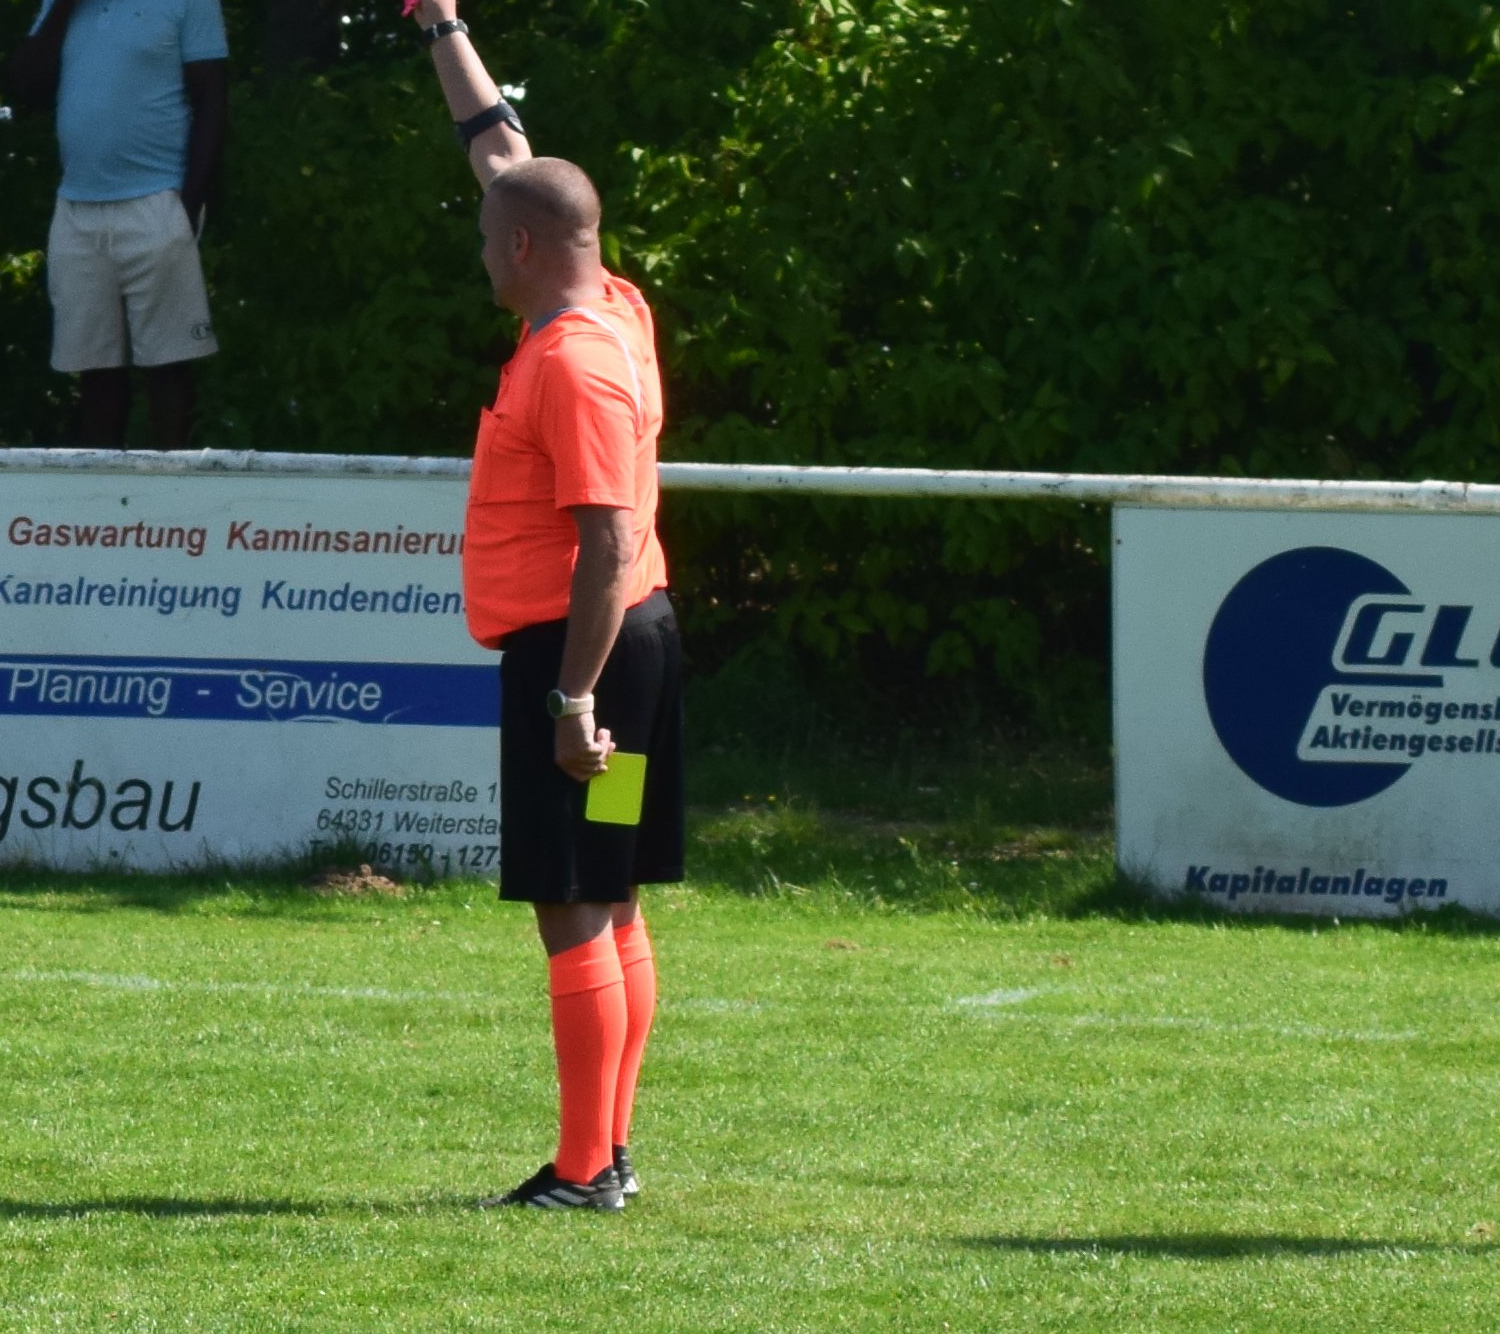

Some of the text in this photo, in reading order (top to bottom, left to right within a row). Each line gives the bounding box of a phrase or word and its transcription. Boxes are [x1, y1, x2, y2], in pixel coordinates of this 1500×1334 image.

[7, 515, 207, 557] Gaswartung
[260, 579, 468, 616] Kundendien
[8, 667, 172, 716] Planung
[235, 669, 383, 711] Service
[324, 775, 478, 803] Schillerstraße
[316, 808, 500, 836] 64331 Weitersta
[457, 844, 501, 868] 127
[1184, 865, 1448, 904] Kapitalanlagen
